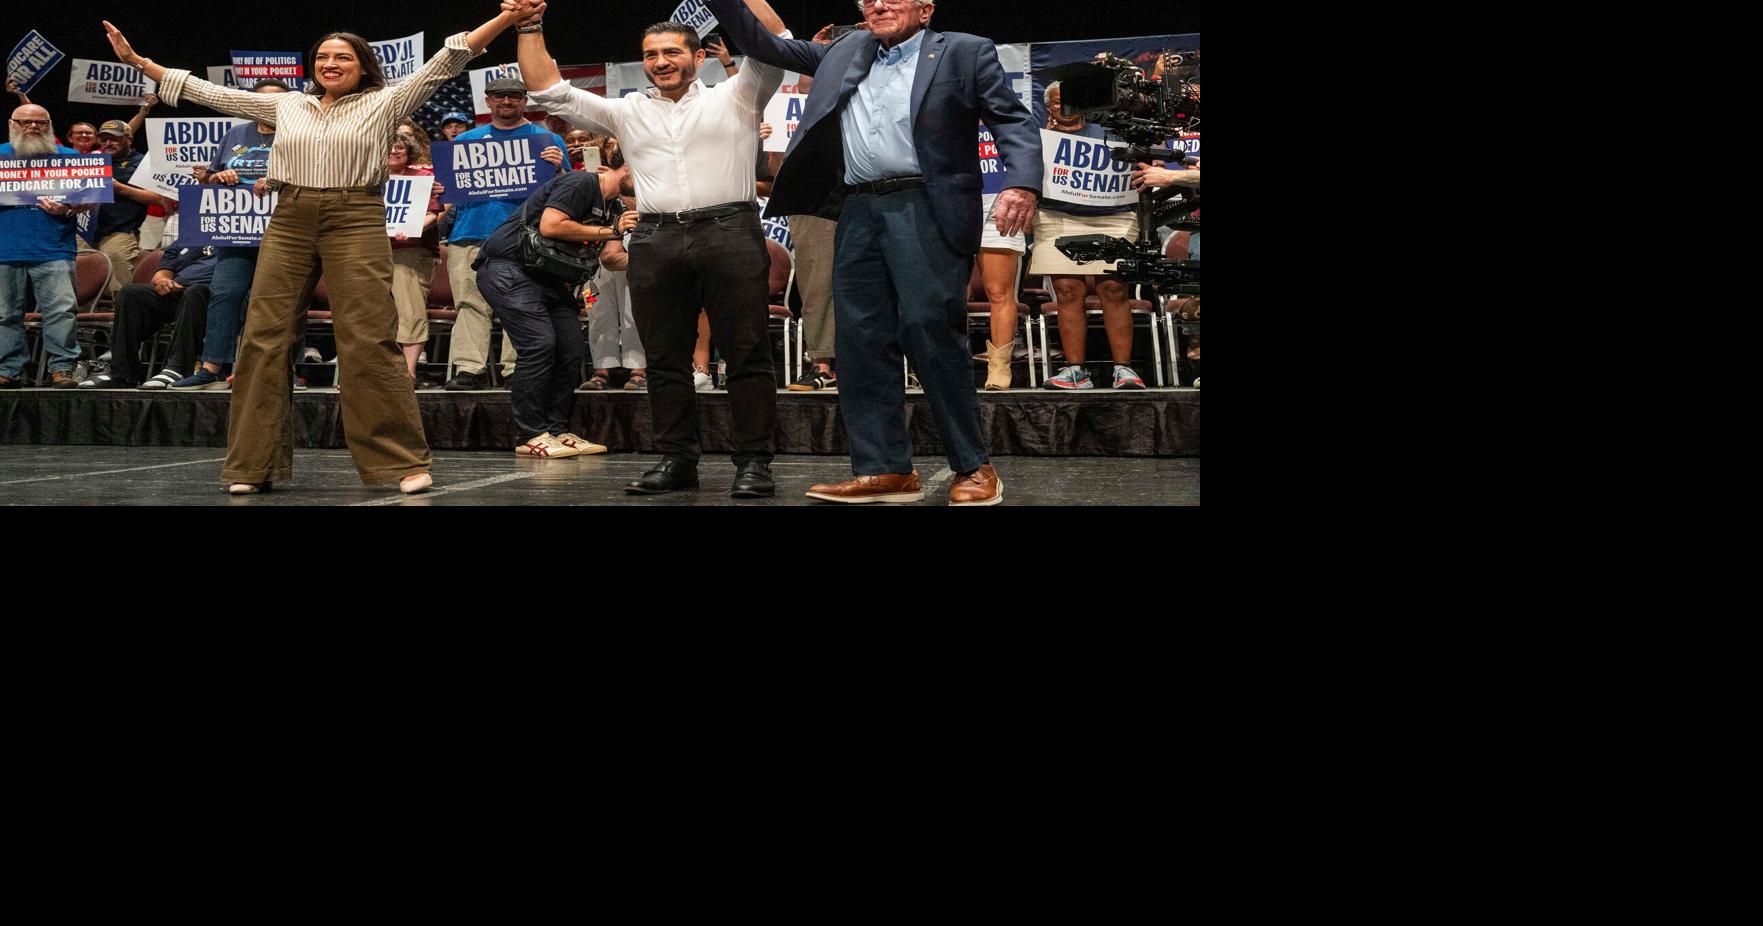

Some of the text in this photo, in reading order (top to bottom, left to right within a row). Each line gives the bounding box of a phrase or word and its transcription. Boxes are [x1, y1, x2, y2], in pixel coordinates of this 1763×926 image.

[371, 40, 415, 64] BDUL
[27, 46, 58, 71] ALL
[255, 57, 263, 65] OF
[265, 56, 297, 65] POLITICS
[251, 67, 268, 75] YOUR
[270, 67, 297, 75] POCKET
[383, 60, 415, 80] ENATE
[99, 82, 146, 97] SENATE
[166, 153, 178, 161] US
[453, 138, 536, 170] ABDUL
[31, 159, 48, 168] OUT
[51, 159, 62, 167] OF
[65, 157, 105, 166] POLITICS
[980, 159, 999, 174] OR
[31, 170, 41, 178] IN
[44, 169, 68, 177] YOUR
[71, 168, 105, 176] POCKET
[455, 172, 471, 180] FOR
[456, 165, 537, 189] US SENATE
[1053, 167, 1069, 176] FOR
[152, 173, 167, 182] US
[1052, 176, 1068, 185] US
[60, 178, 82, 189] FOR
[86, 178, 106, 188] ALL
[201, 215, 272, 233] US SENAT
